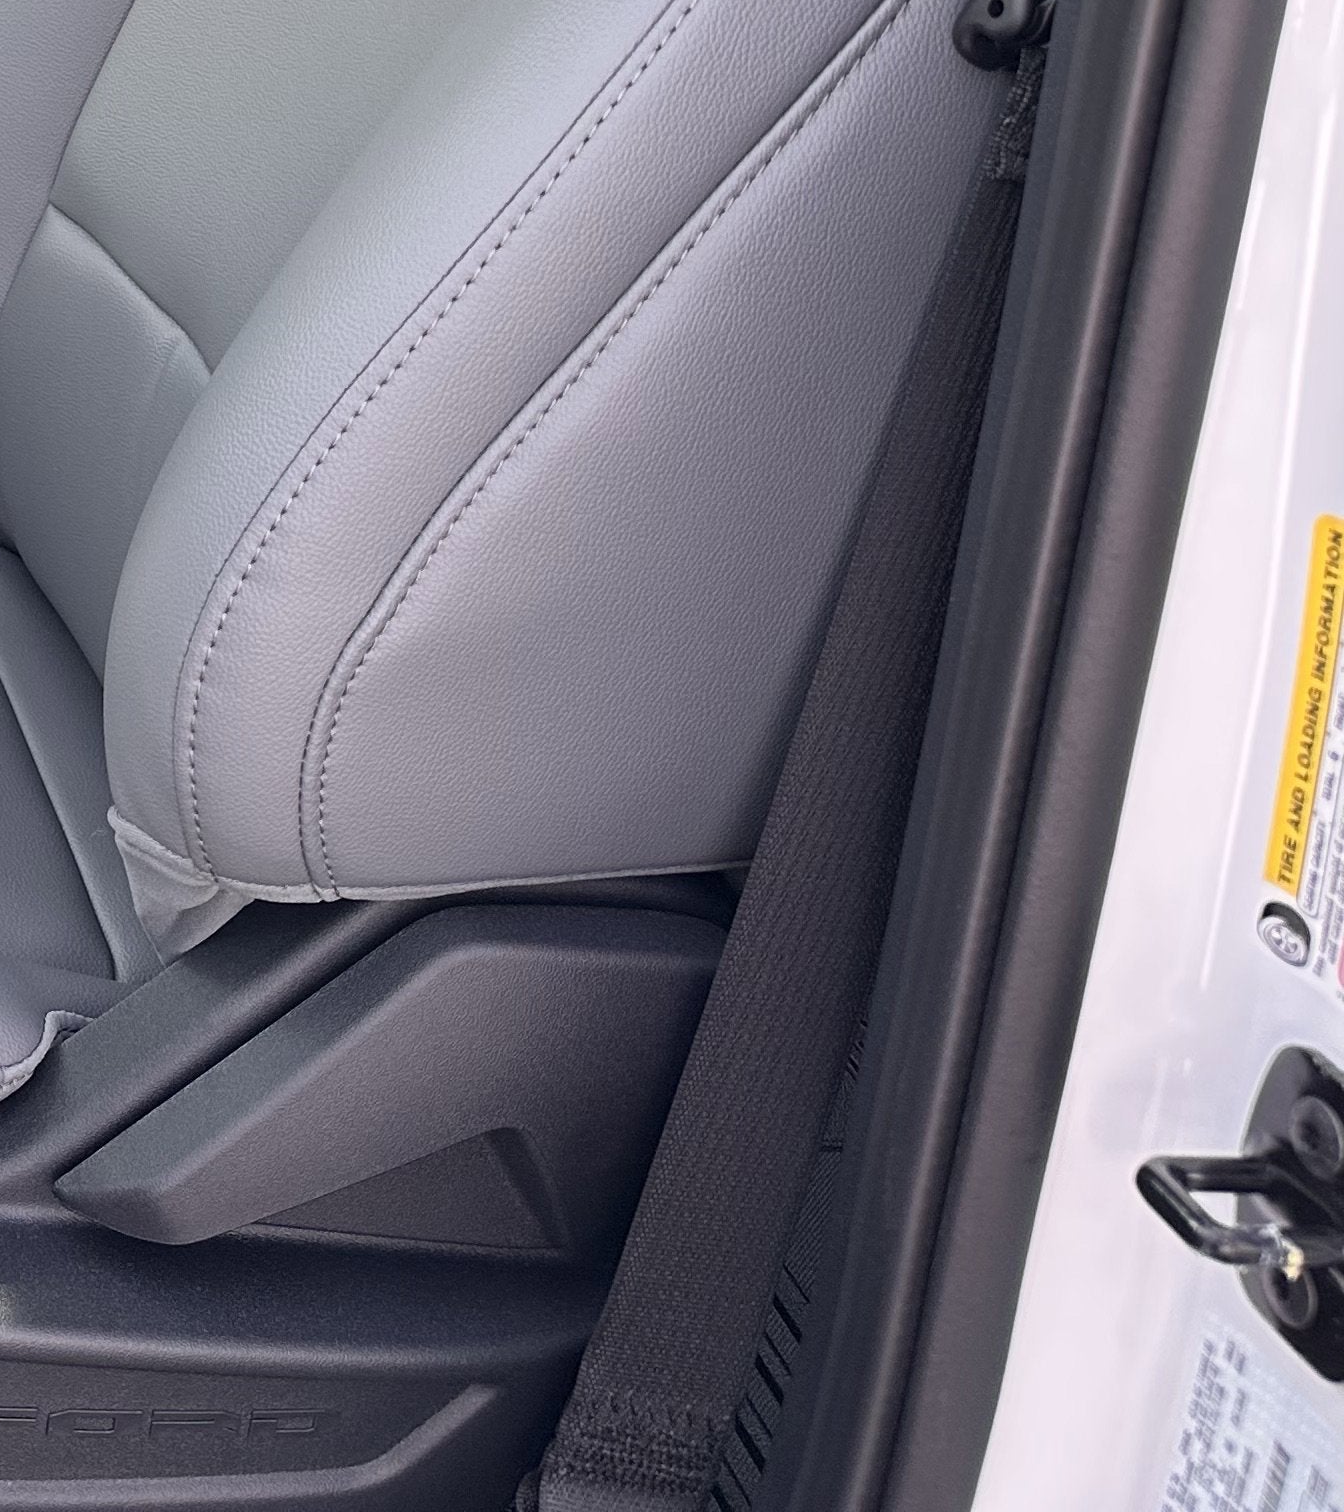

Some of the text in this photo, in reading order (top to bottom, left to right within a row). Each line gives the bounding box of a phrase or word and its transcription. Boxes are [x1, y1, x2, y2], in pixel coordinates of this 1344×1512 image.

[1311, 527, 1344, 683] INFORMATION
[1295, 686, 1322, 783] LOADING
[1286, 787, 1306, 831] AND
[1278, 834, 1297, 886] TIRE
